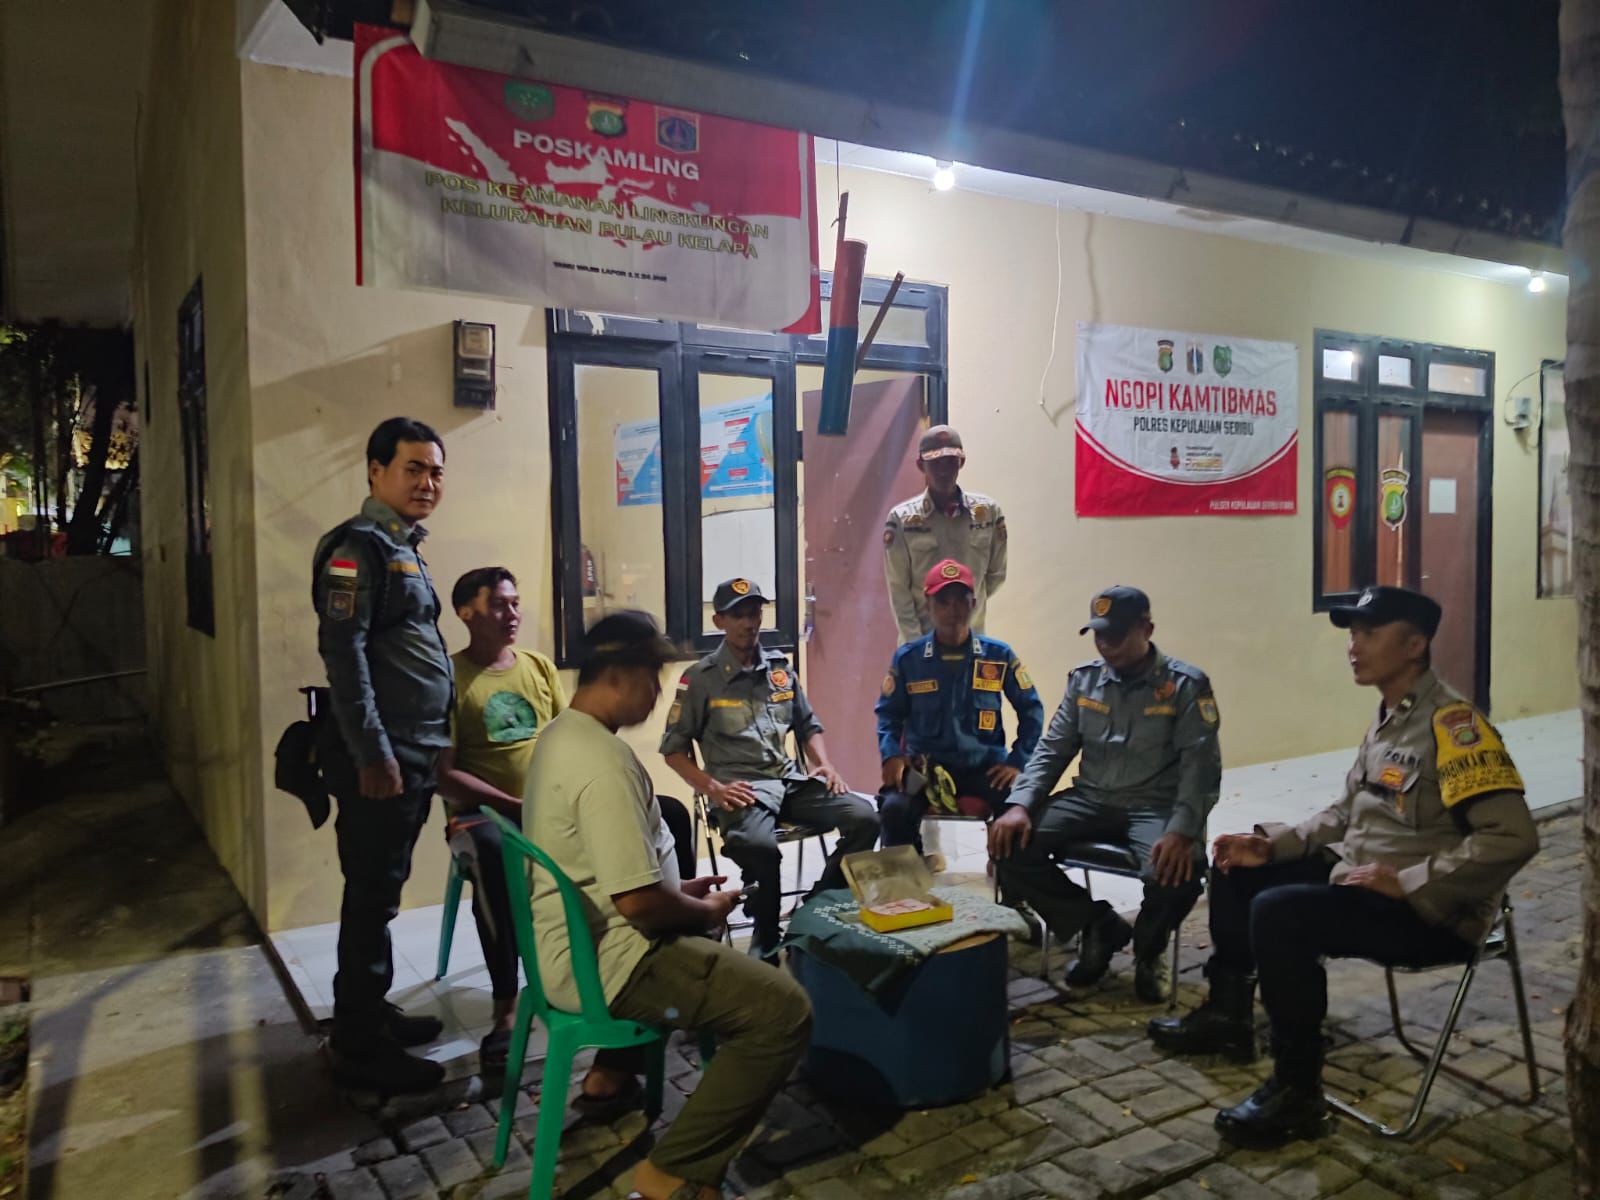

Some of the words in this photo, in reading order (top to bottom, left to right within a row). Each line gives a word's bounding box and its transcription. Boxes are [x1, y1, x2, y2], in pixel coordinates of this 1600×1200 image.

[513, 128, 700, 181] POSKAMLING
[425, 170, 480, 193] POS
[486, 181, 625, 218] KEAMANAN
[631, 204, 769, 239] LINGKUNGAN
[441, 197, 592, 234] KELURAHAN
[599, 221, 672, 245] PULAU
[678, 232, 758, 259] KELAPA
[1105, 378, 1163, 411] NGOPI
[1169, 383, 1277, 416] KAMTIBMAS
[1133, 416, 1169, 433] POLRES
[1170, 419, 1222, 434] KEPULAUAN
[1223, 420, 1254, 436] SERIBU
[1383, 750, 1423, 769] POLRI
